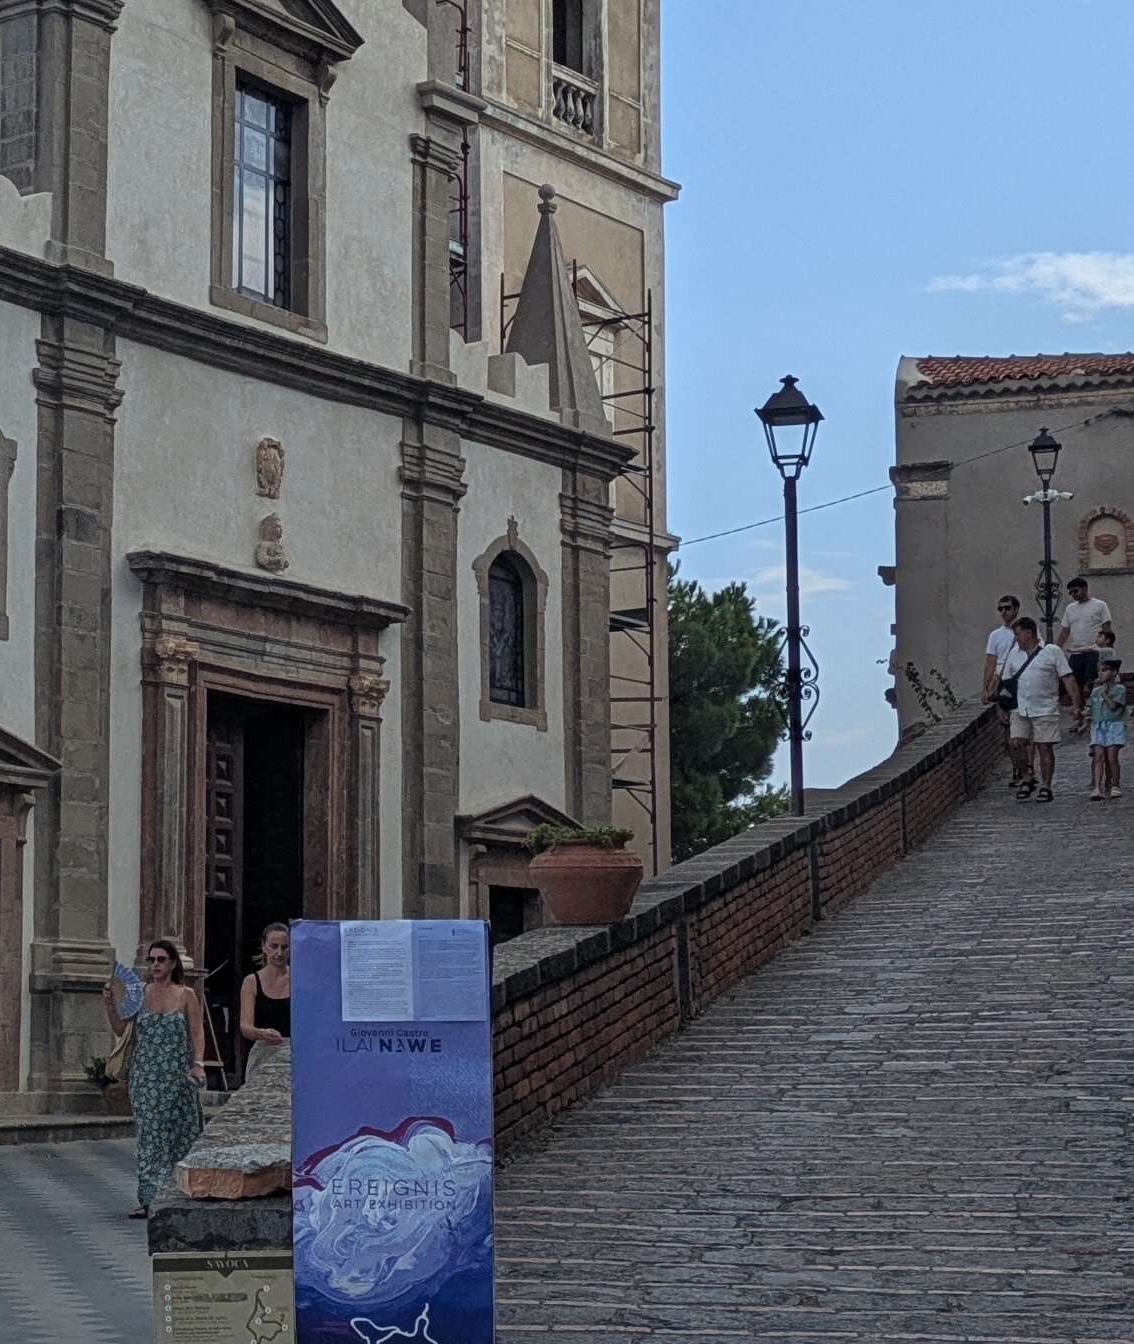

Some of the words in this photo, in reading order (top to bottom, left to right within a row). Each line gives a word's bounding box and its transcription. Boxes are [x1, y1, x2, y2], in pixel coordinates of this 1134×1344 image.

[350, 1028, 394, 1038] Giovanni
[396, 1029, 429, 1038] Castro
[379, 1038, 442, 1053] NAWE
[332, 1178, 456, 1197] EREIGNIS
[333, 1199, 362, 1209] ART
[369, 1199, 457, 1211] EXHIBITION
[206, 1258, 249, 1269] SAVOCA
